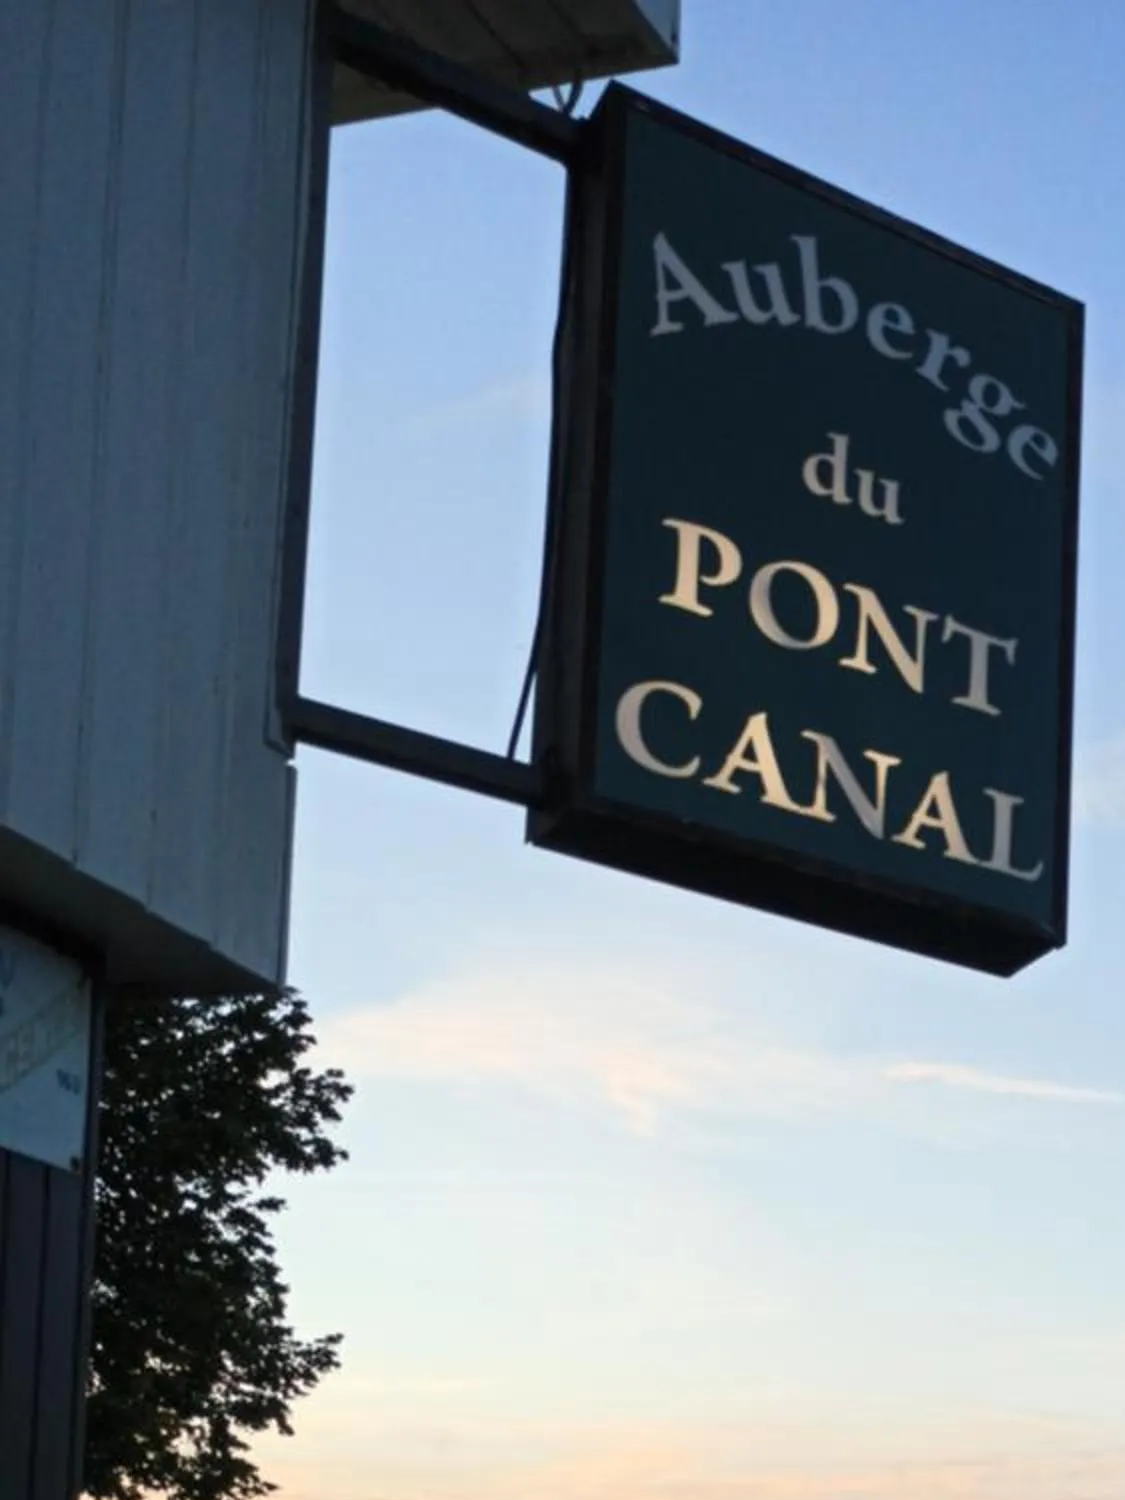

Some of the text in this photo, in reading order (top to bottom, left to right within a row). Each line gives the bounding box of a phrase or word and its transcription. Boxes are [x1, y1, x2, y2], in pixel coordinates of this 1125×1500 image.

[651, 232, 1058, 480] Auberge
[802, 432, 904, 525] du
[659, 517, 1018, 717] PONT
[615, 680, 1045, 882] CANAL
